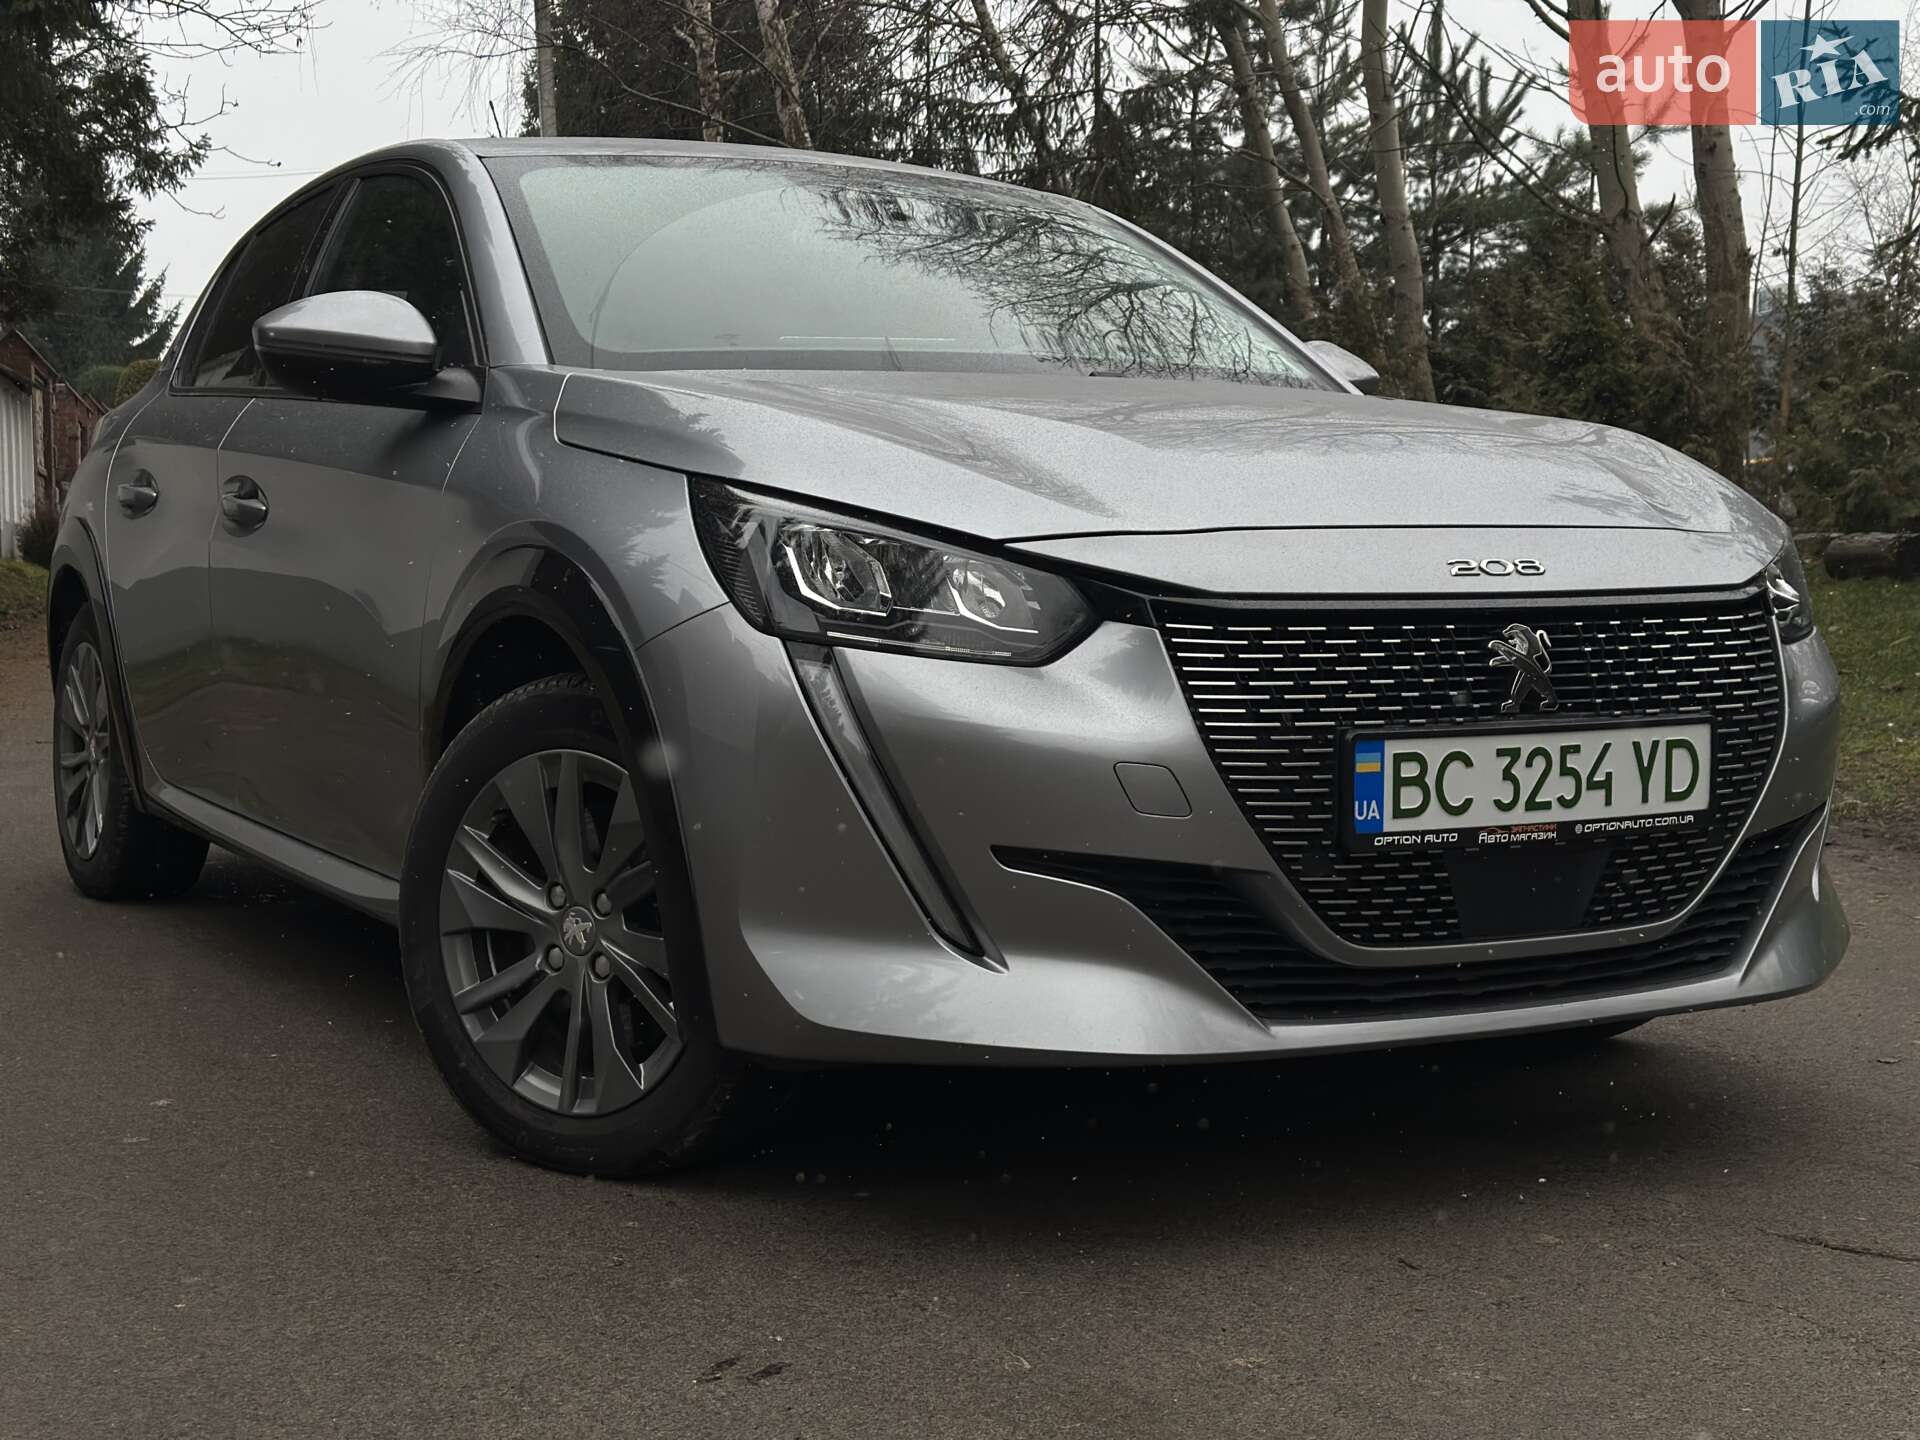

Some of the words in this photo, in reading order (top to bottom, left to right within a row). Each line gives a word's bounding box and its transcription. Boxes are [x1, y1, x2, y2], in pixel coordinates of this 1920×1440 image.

[1447, 558, 1545, 576] 208
[1392, 750, 1474, 819] BC
[1492, 741, 1613, 812] 3254
[1632, 739, 1700, 803] YD
[1354, 799, 1380, 820] UA
[1424, 833, 1458, 843] AUTO
